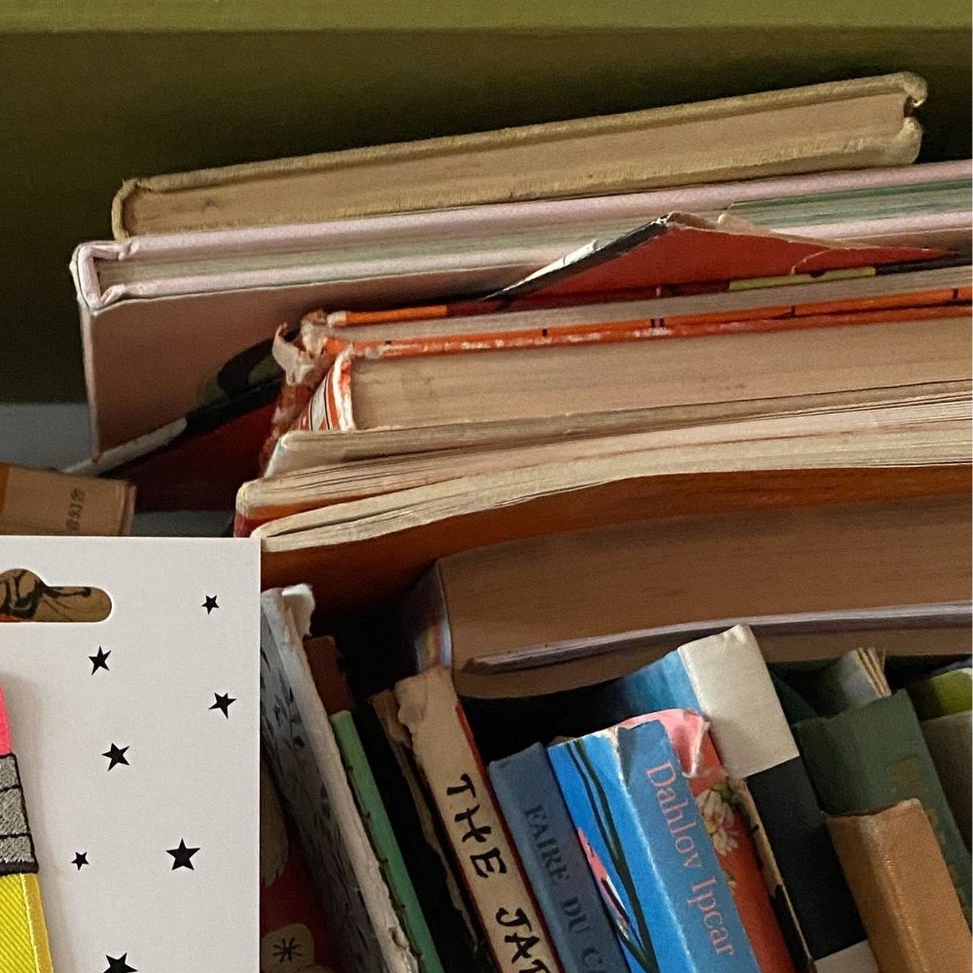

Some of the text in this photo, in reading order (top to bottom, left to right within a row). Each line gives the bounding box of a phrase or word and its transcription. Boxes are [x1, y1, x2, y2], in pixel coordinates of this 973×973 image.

[446, 773, 507, 878] THE
[524, 802, 569, 882] FAIRE
[562, 899, 591, 937] DU
[647, 760, 734, 955] Dahlov Ipcar
